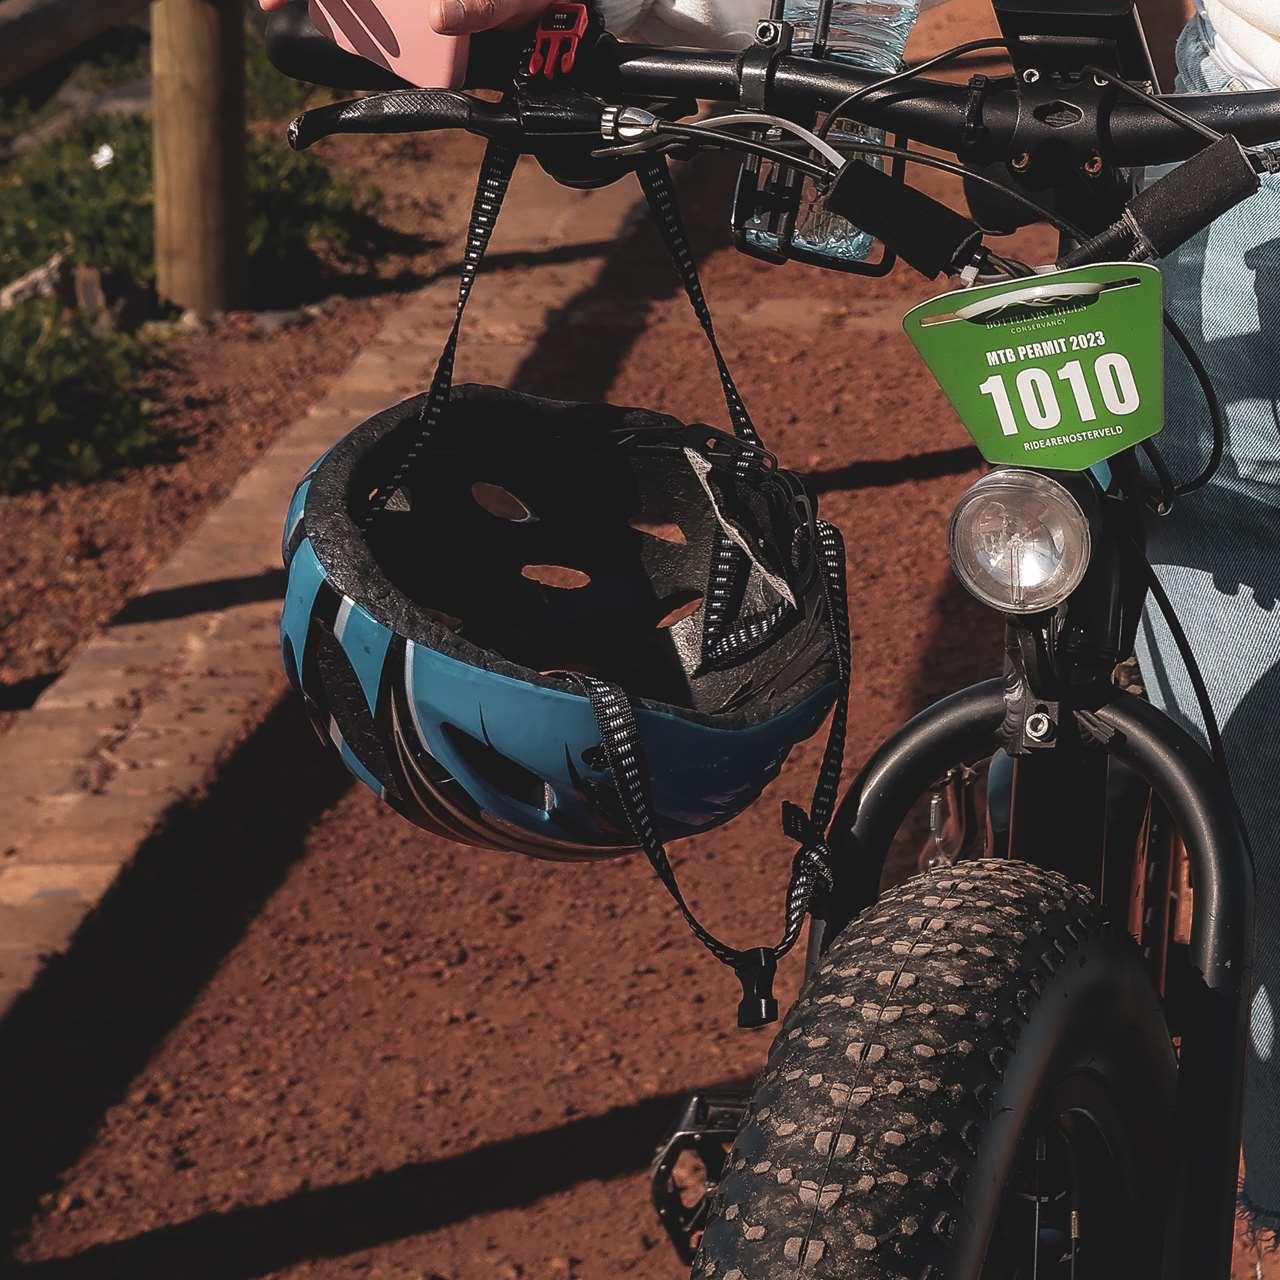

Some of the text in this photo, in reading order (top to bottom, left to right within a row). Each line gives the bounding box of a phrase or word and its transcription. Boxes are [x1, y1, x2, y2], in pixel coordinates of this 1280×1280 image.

[1010, 318, 1067, 334] CONSERVANCY
[986, 331, 1106, 366] MTB PERMIT 2023
[978, 352, 1141, 436] 1010
[1023, 425, 1124, 451] RIDE4RENOSTERVELD
